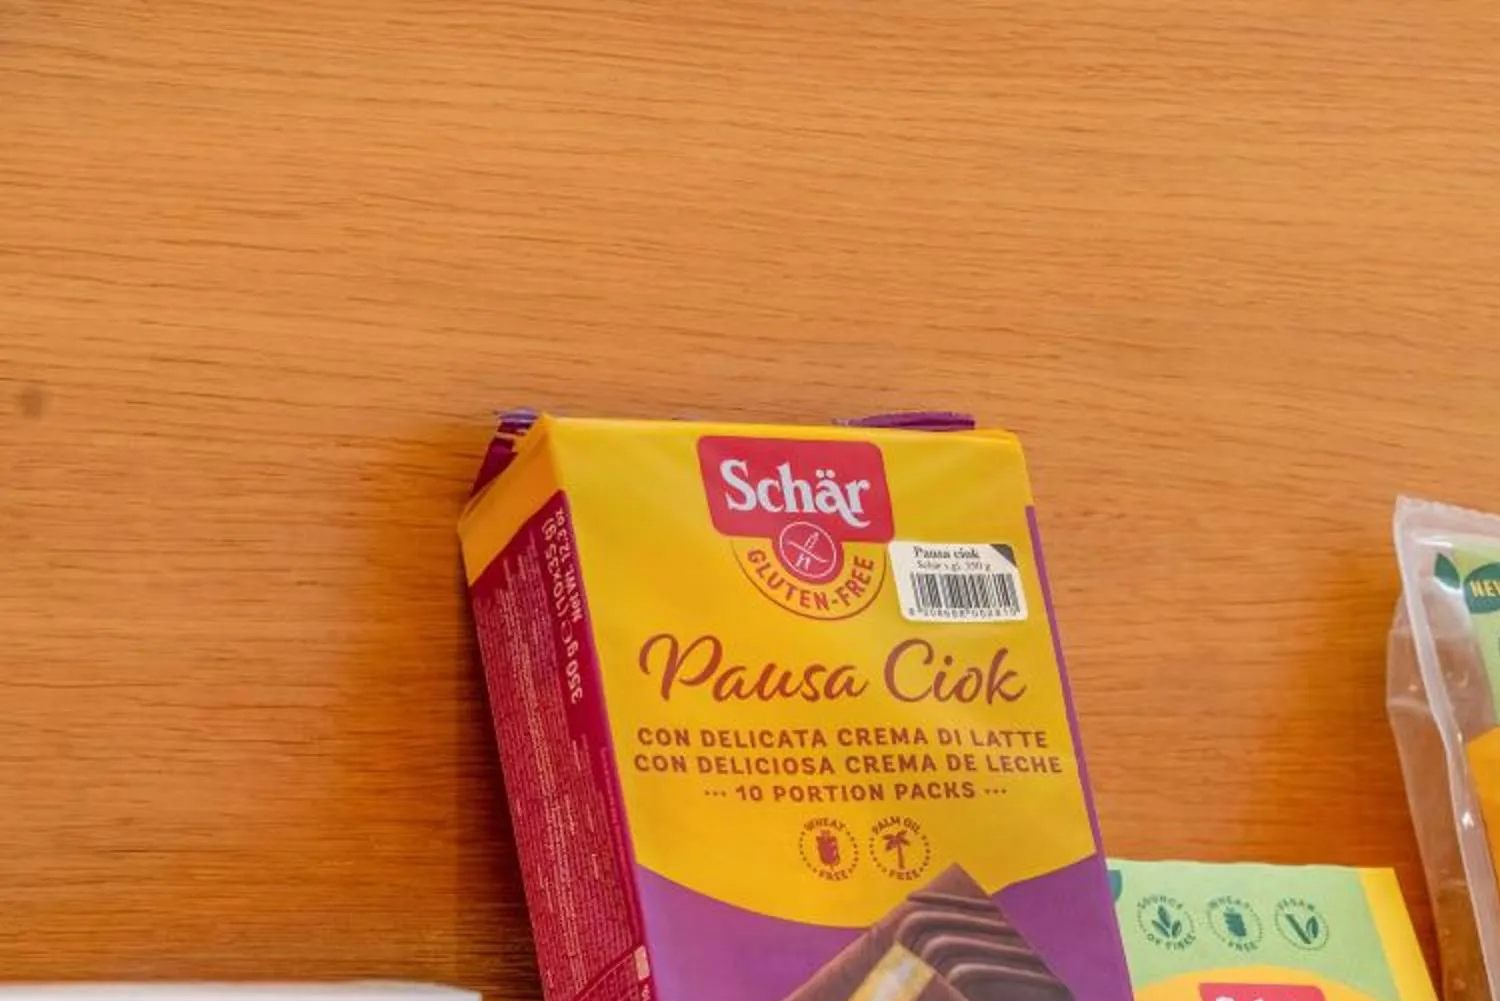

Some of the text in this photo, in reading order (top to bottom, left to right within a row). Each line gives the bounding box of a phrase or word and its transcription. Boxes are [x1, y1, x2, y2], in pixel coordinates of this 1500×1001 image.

[719, 459, 872, 528] Schär
[746, 547, 875, 613] GLUTEN-FREE
[565, 660, 583, 704] 350
[638, 633, 1028, 705] Pausa Ciok
[636, 726, 1049, 749] CON DELICATA CREMA DI LATTE
[633, 753, 1063, 775] CON DELICIOSA CREMA DE LECHE
[735, 780, 976, 802] 10 PORTION PACKS
